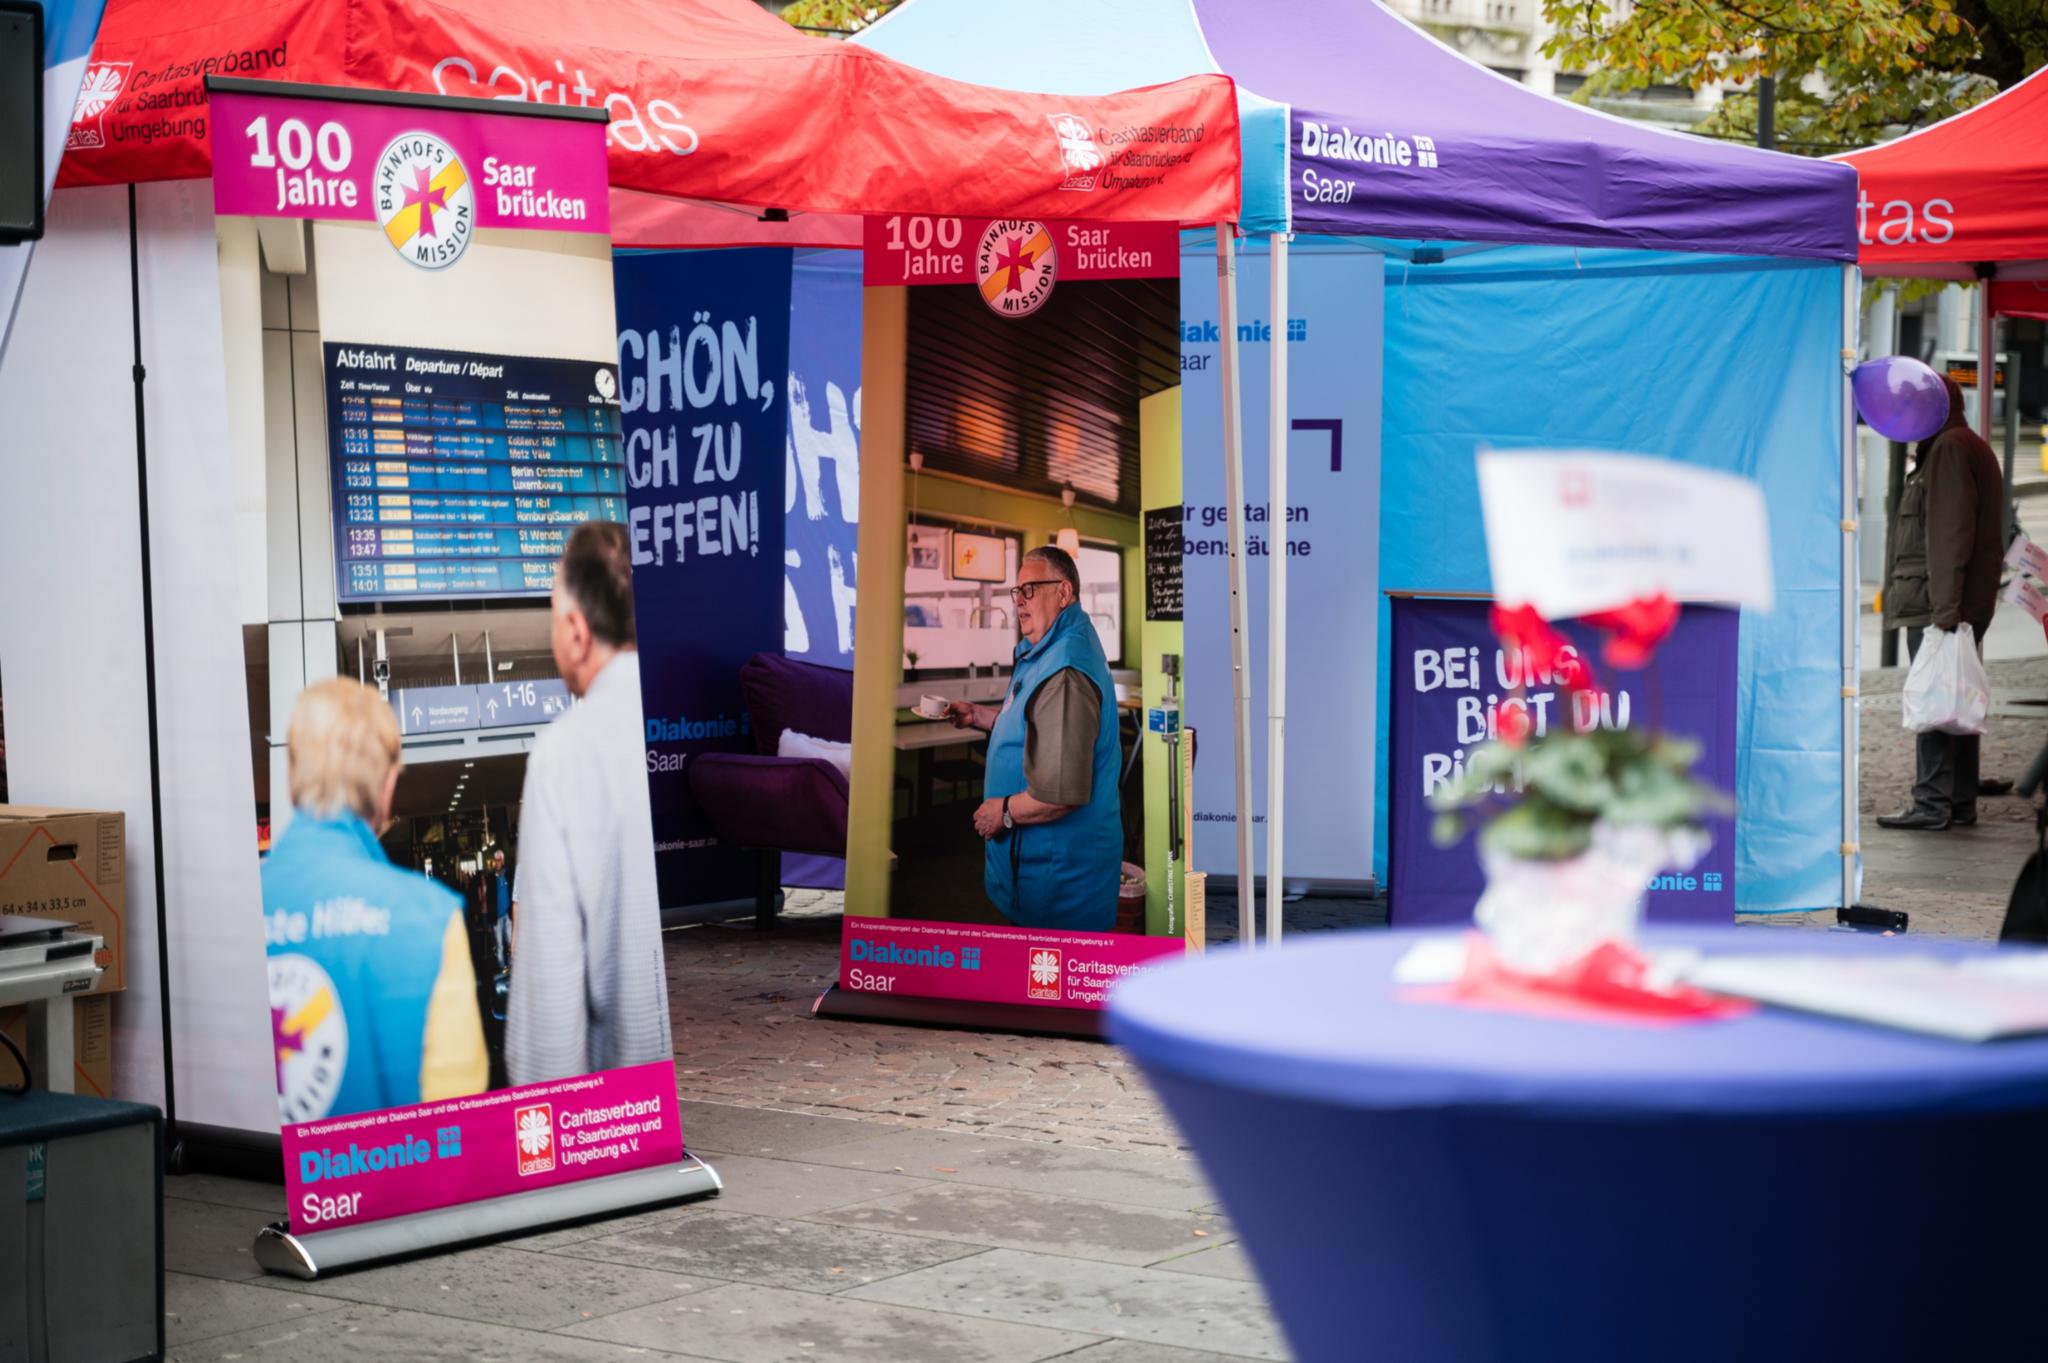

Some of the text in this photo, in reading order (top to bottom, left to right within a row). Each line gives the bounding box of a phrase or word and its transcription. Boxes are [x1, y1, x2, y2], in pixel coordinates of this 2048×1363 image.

[130, 41, 288, 92] Caritasverband
[66, 127, 99, 147] aritas
[111, 117, 206, 144] Umgebung
[1099, 122, 1205, 146] Caritasverband
[246, 117, 352, 171] 100
[1301, 121, 1412, 167] Diakonie
[381, 140, 444, 211] BAHNHOFS
[483, 158, 536, 187] Saar
[277, 169, 358, 211] Jahre
[1302, 168, 1355, 204] Saar
[497, 187, 586, 221] brücken
[1857, 190, 1954, 245] tas
[416, 205, 469, 263] MISSION
[886, 215, 962, 250] 100
[1067, 225, 1110, 247] Saar
[980, 219, 1036, 275] BAHNHOFS
[1077, 246, 1152, 271] brücken
[903, 248, 964, 280] Jahre
[1003, 264, 1053, 311] MISSION
[1180, 320, 1271, 342] iaknie
[336, 348, 504, 379] Abfahrt Departure / Départ
[618, 310, 774, 414] CHÖN,
[1180, 354, 1211, 371] aar
[343, 428, 369, 441] 13:19
[344, 441, 369, 454] 13:21
[508, 448, 530, 459] Metz
[625, 424, 678, 489] CH
[692, 421, 742, 484] ZU
[345, 461, 371, 473] 13:24
[511, 465, 584, 478] Berlin Ostbahnhof
[346, 474, 372, 487] 13:30
[512, 478, 563, 492] Luxembourg
[347, 494, 373, 506] 13:31
[515, 497, 533, 508] Trier
[535, 497, 551, 508] Hbf
[348, 508, 375, 521] 13:32
[349, 528, 376, 542] 13:35
[630, 490, 760, 567] EFFEN!
[350, 543, 377, 556] 13:47
[520, 542, 563, 554] Mannheim
[351, 563, 378, 577] 13:51
[522, 561, 546, 574] Mainz
[352, 579, 379, 592] 14:01
[1495, 644, 1581, 690] UNS
[502, 682, 536, 707] 1-16
[1572, 689, 1631, 734] DU
[646, 714, 737, 743] Diakonie
[646, 750, 687, 773] Saar
[1647, 872, 1698, 891] onie
[2, 903, 15, 916] 64
[25, 900, 39, 913] 34
[49, 896, 70, 911] 33,5
[72, 897, 87, 908] cm
[850, 921, 860, 929] Ein
[860, 922, 911, 933] Kooperationsprojekt
[921, 926, 945, 935] Diakonie
[946, 927, 959, 936] Saar
[960, 929, 970, 937] und
[971, 930, 981, 938] des
[982, 930, 1027, 941] Caritasverbandes
[1028, 934, 1060, 943] Saarbrücken
[1061, 936, 1071, 944] und
[1072, 937, 1103, 947] Umgebung
[849, 938, 956, 968] Diakonie
[848, 968, 896, 992] Saar
[1067, 975, 1120, 989] für Saarbr
[1030, 988, 1058, 998] caritas
[1067, 989, 1112, 1003] Umgebu
[297, 1127, 310, 1138] Ein
[311, 1117, 376, 1135] Kooperationsprojekt
[376, 1114, 388, 1124] der
[389, 1110, 417, 1123] Diakonie
[418, 1107, 432, 1118] Saar
[434, 1105, 446, 1115] und
[446, 1103, 459, 1112] des
[459, 1093, 512, 1111] Caritasverbandes
[511, 1086, 549, 1102] Saarbrücken
[549, 1084, 562, 1095] und
[562, 1078, 594, 1093] Umgebung
[559, 1095, 661, 1130] Caritasverband
[560, 1117, 662, 1148] für Saarbrücken und
[298, 1133, 432, 1184] Diakonie
[561, 1143, 620, 1166] Umgebung
[629, 1138, 640, 1152] V.
[521, 1157, 553, 1173] caritas
[301, 1190, 362, 1225] Saar
